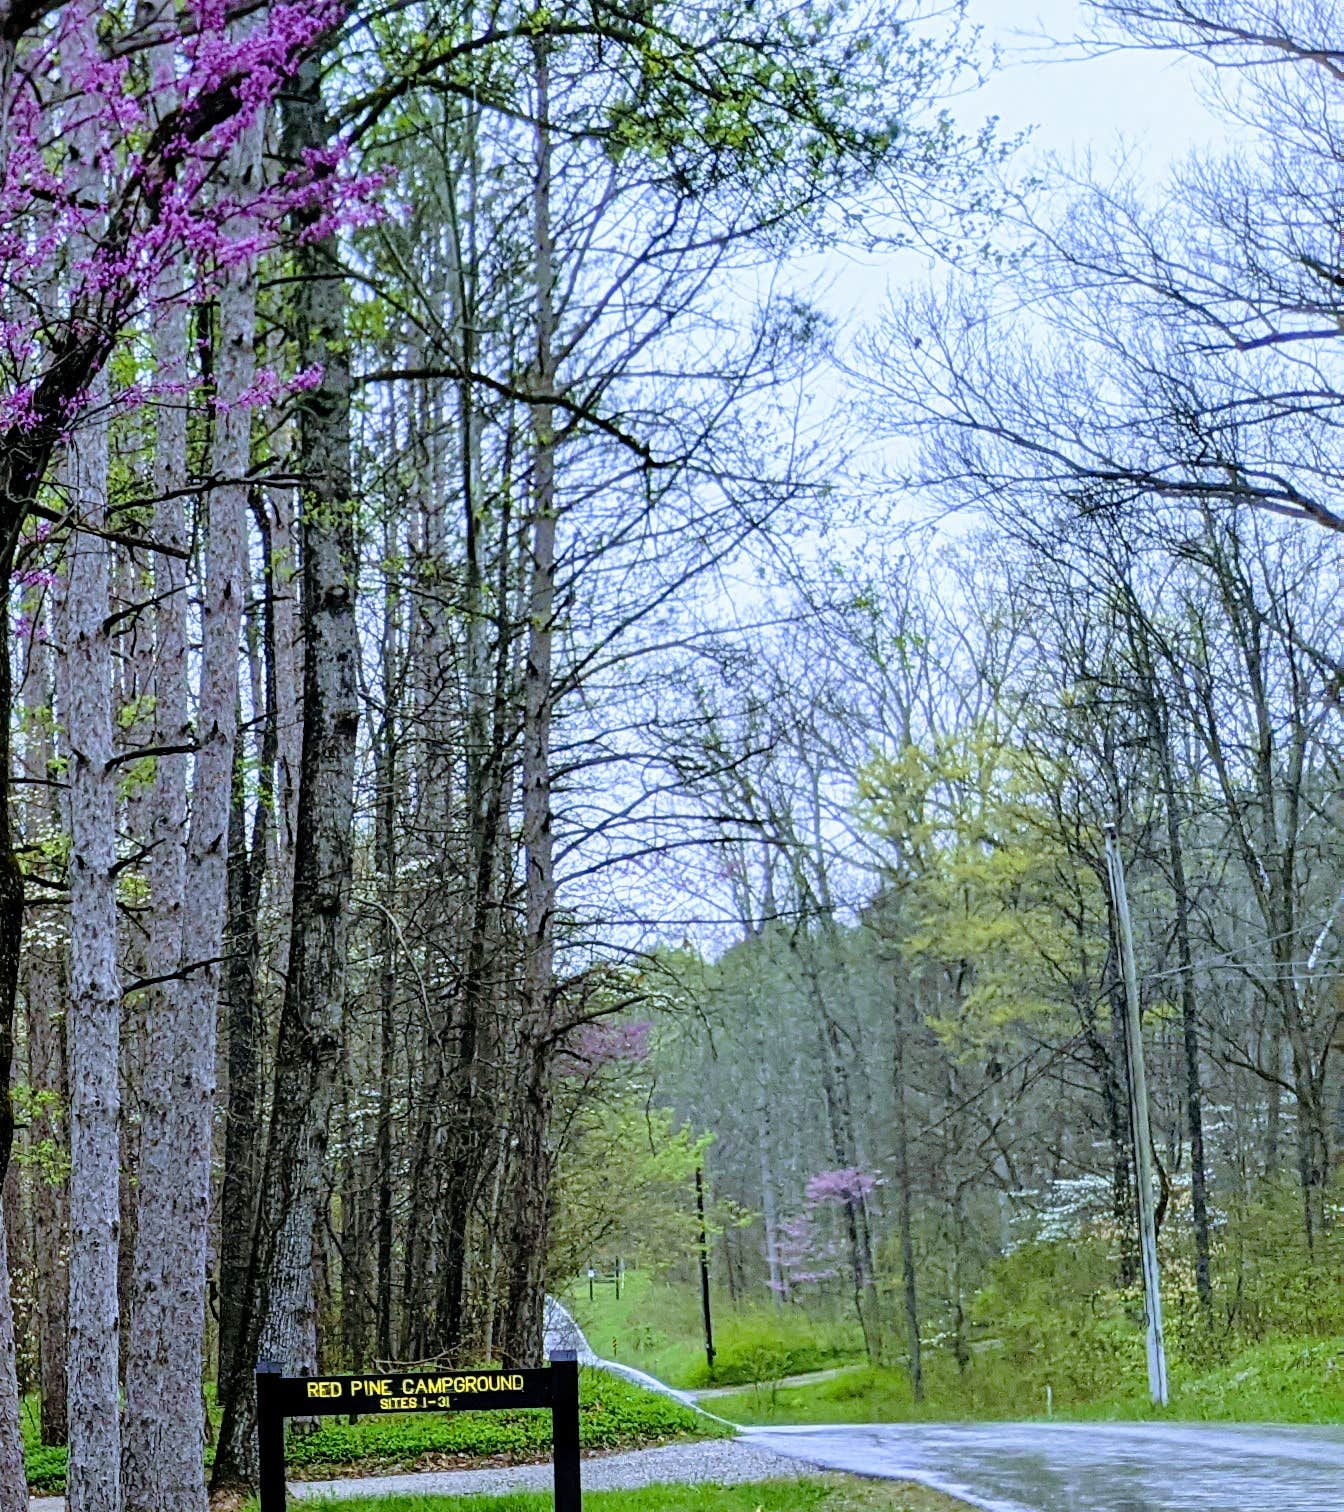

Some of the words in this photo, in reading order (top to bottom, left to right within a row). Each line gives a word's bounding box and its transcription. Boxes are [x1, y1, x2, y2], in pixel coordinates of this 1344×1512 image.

[307, 1381, 342, 1398] RED
[350, 1379, 393, 1397] PINE
[402, 1375, 524, 1394] CAMPGROUND
[380, 1397, 417, 1409] SITES
[422, 1396, 450, 1408] 1-31
